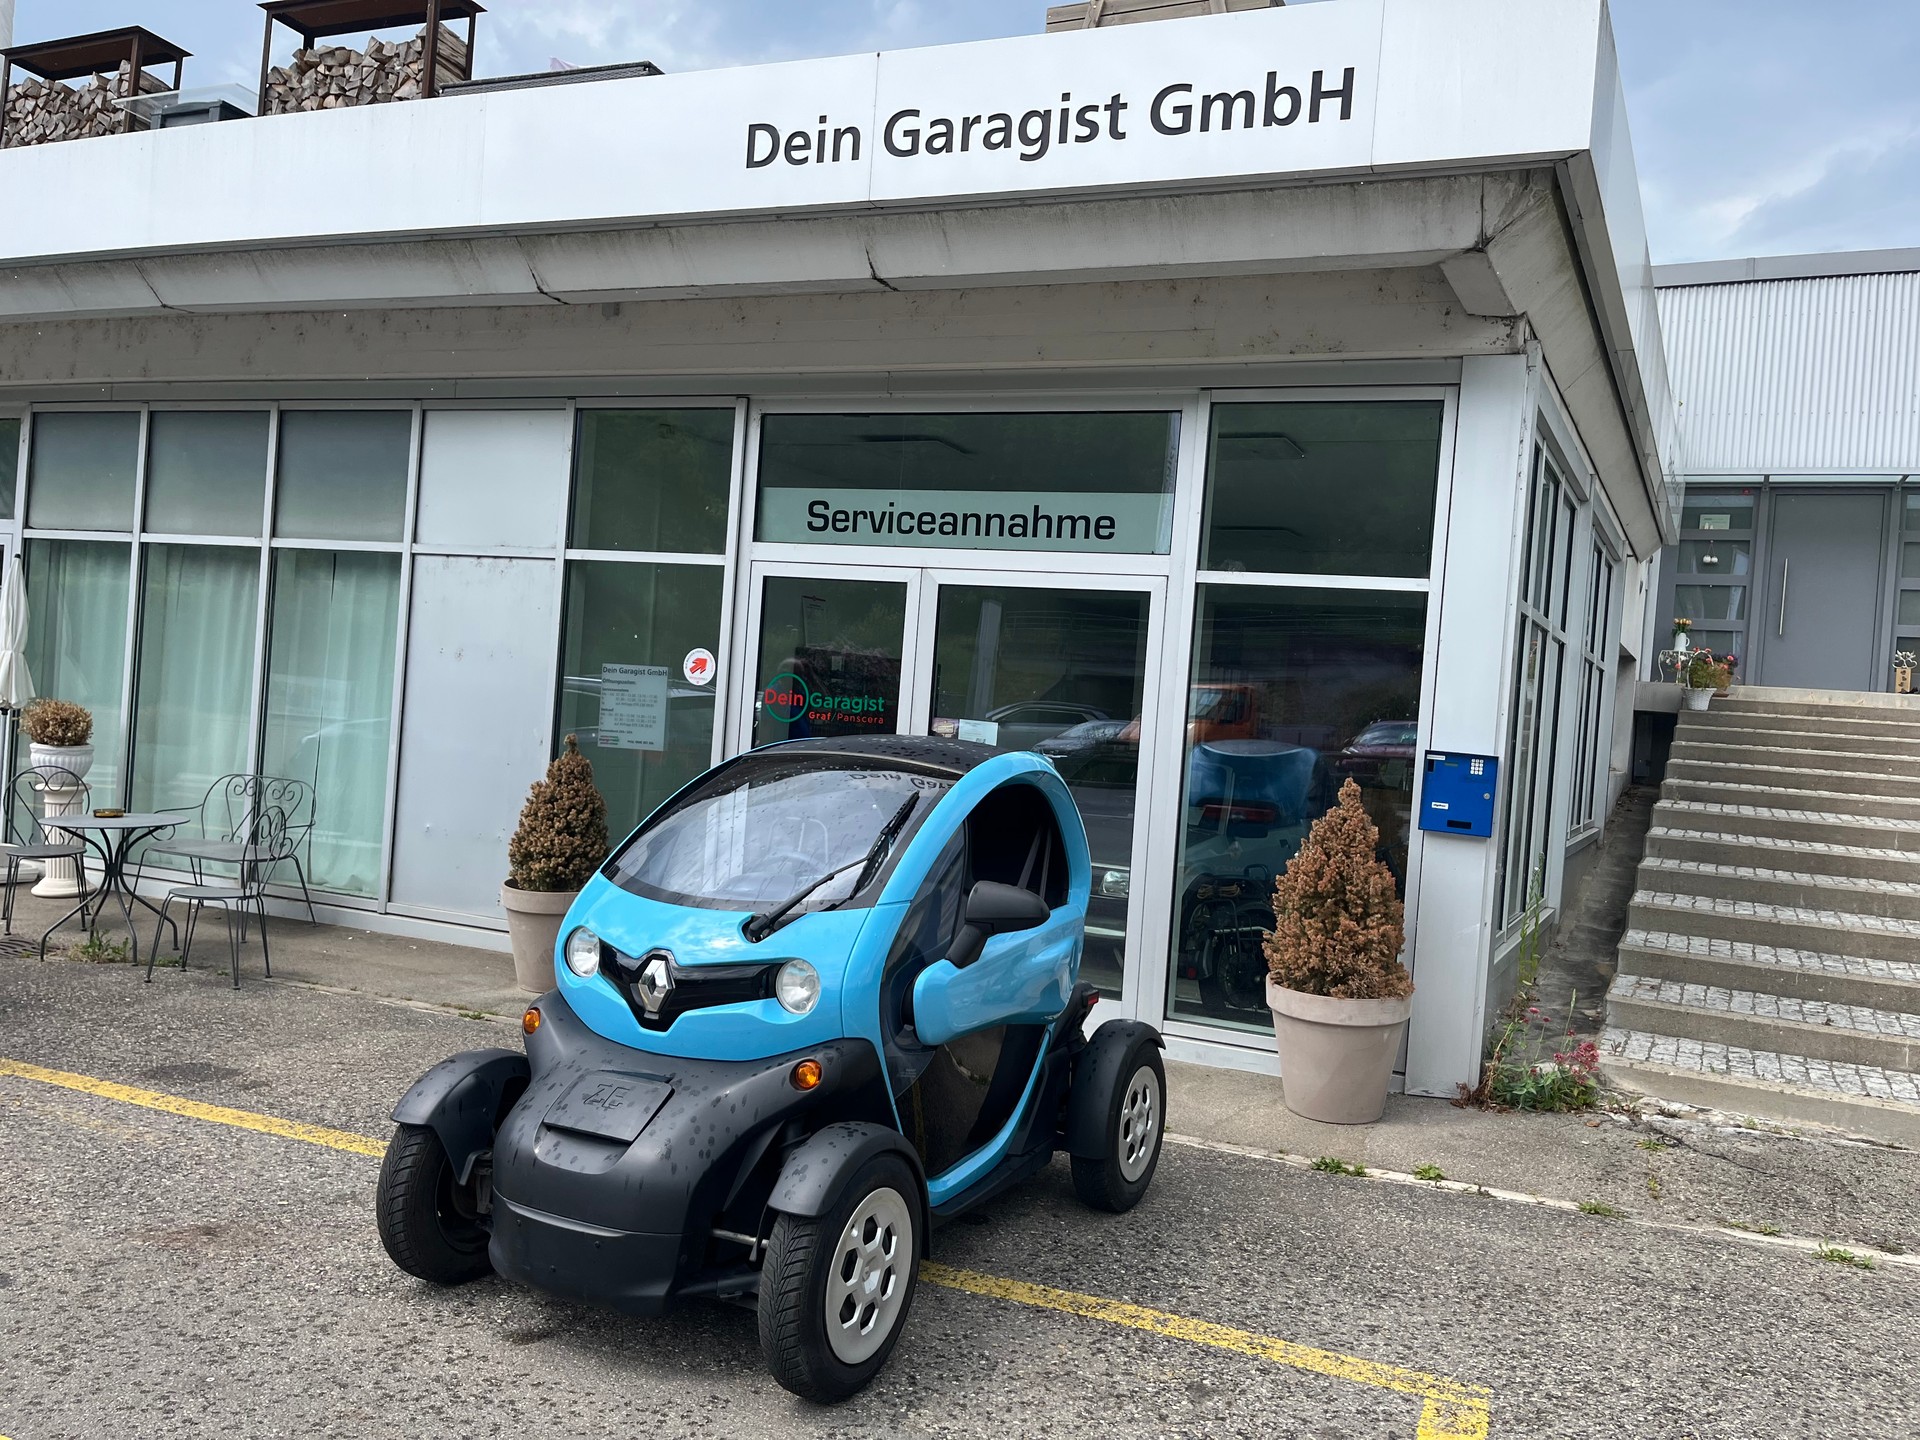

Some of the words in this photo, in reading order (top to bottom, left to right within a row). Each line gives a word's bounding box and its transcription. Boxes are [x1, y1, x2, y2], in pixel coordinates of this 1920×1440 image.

[745, 115, 861, 169] Dein
[883, 92, 1128, 162] Garagist
[1149, 67, 1355, 136] GmbH
[807, 500, 1116, 540] Serviceannahme
[602, 666, 617, 674] Dein
[619, 667, 646, 676] Garagist
[647, 668, 667, 676] GmbH
[764, 688, 804, 706] Dein
[809, 692, 885, 713] Garagist
